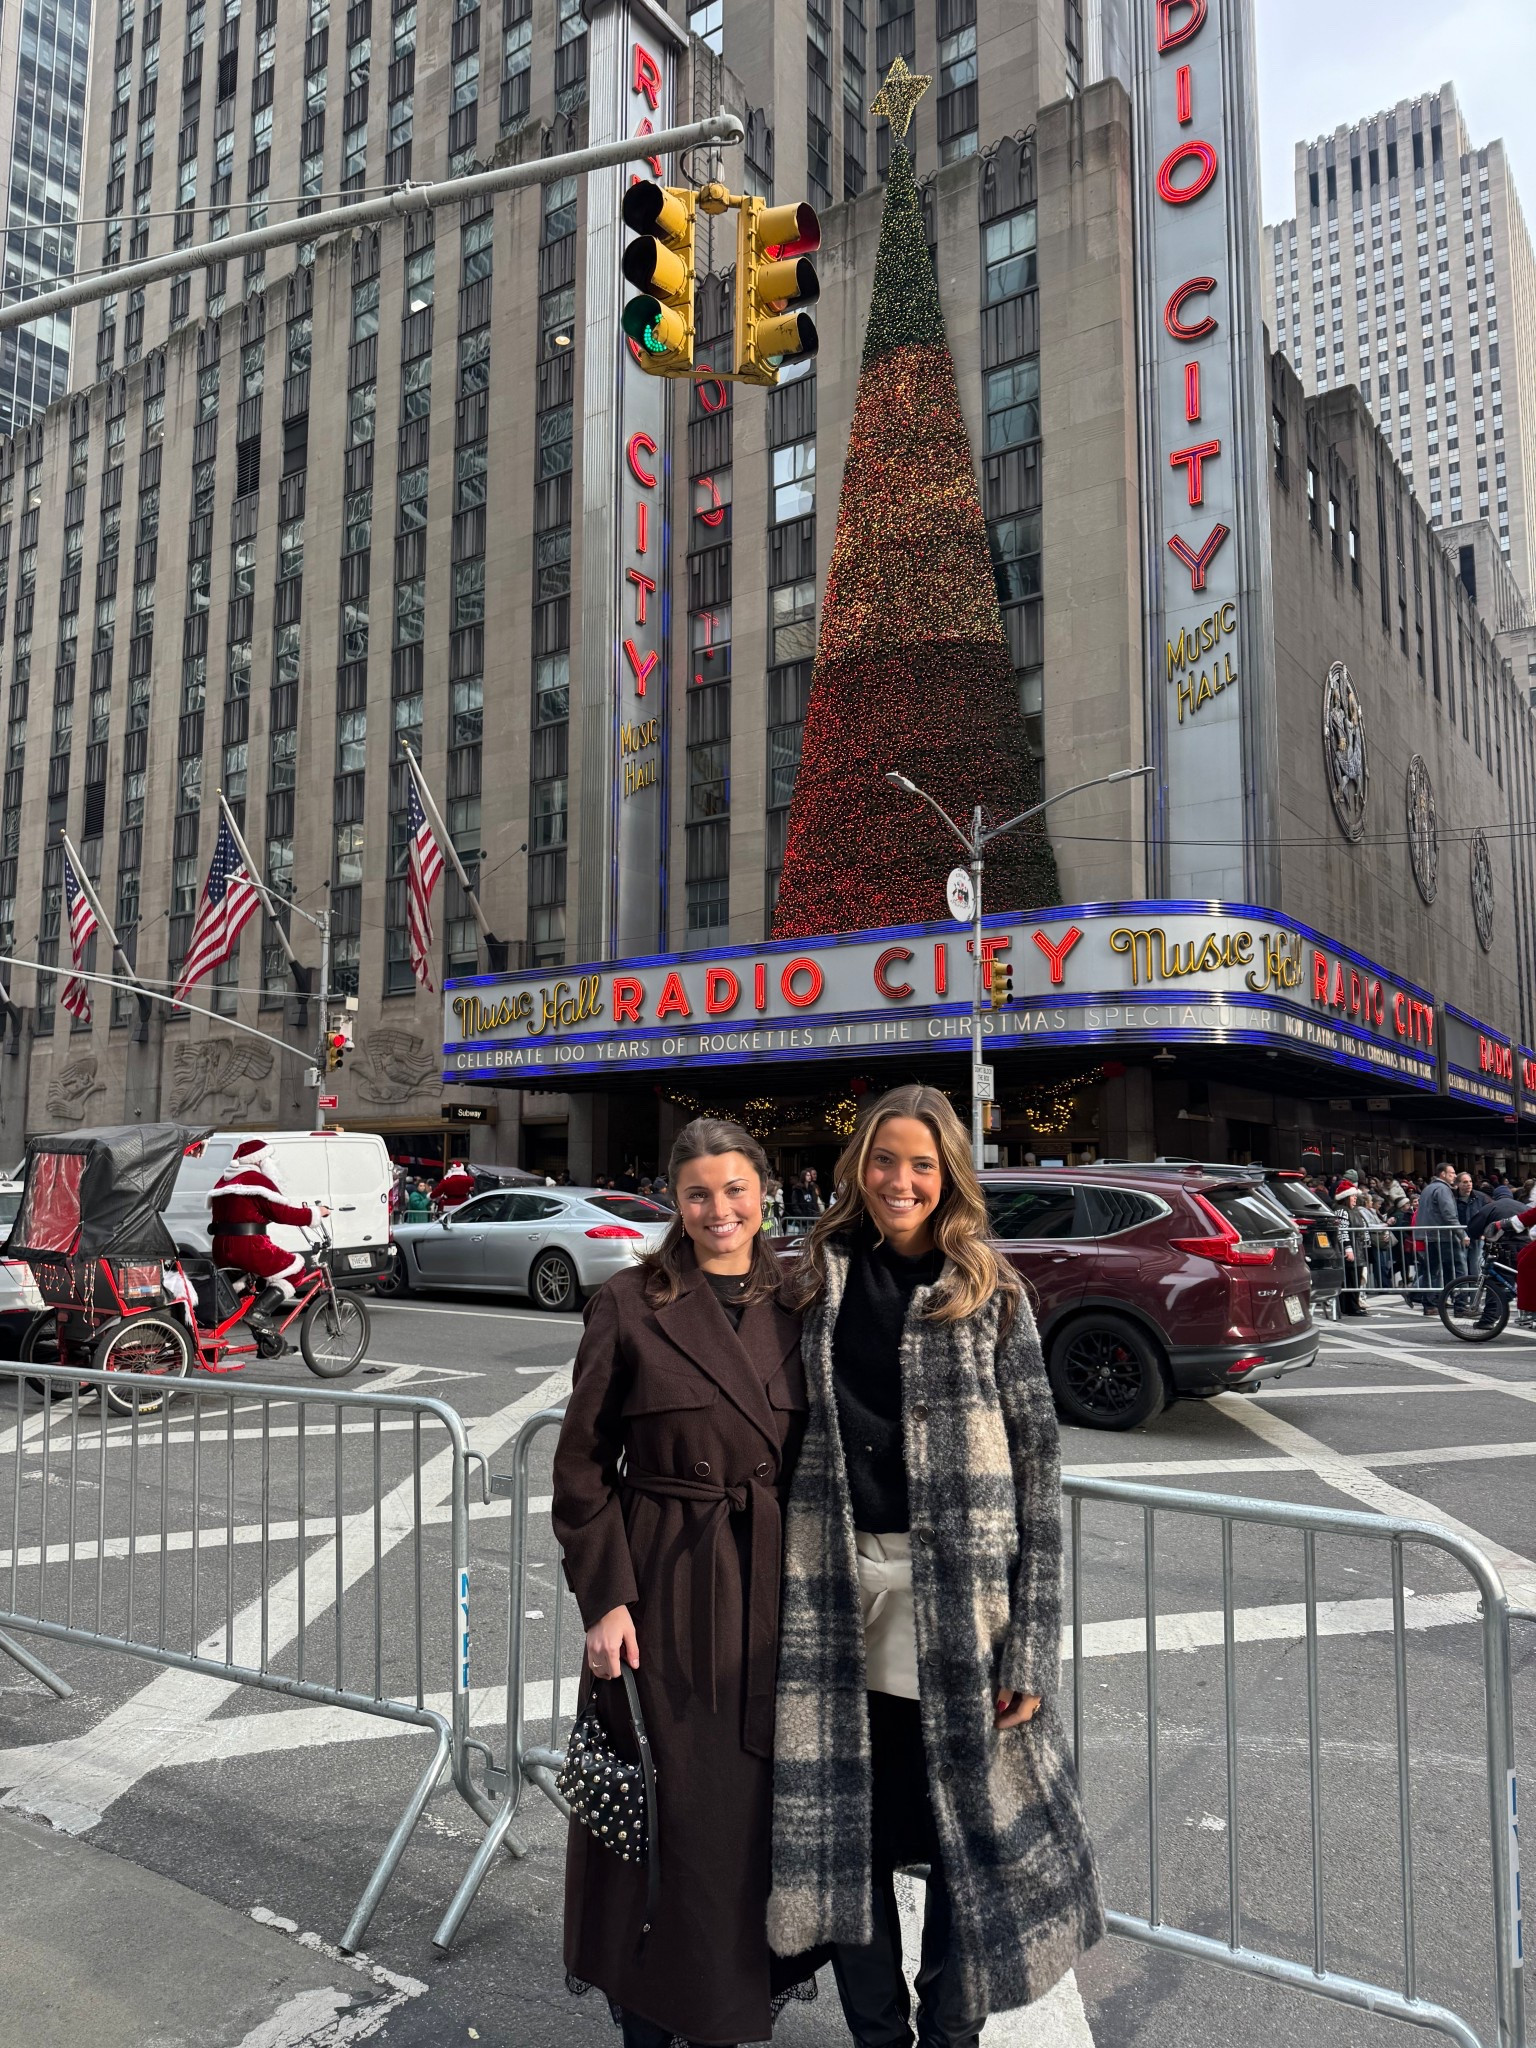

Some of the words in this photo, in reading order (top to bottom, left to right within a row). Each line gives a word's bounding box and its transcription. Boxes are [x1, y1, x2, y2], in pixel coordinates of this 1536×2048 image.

[1163, 276, 1231, 592] CITY
[623, 431, 659, 698] CITY
[1167, 602, 1237, 684] MUSIC
[1177, 652, 1238, 725] HALL
[620, 717, 659, 759] MUSIC
[623, 757, 657, 799] HALL
[453, 990, 535, 1039] Music
[527, 974, 602, 1037] Hall
[613, 956, 824, 1023] RADIO
[873, 925, 1084, 1000] CITY
[1110, 926, 1255, 987] Music
[1313, 950, 1384, 1026] RADIO
[1393, 992, 1435, 1047] CITY
[456, 1048, 543, 1070] CELEBRATE
[554, 1044, 585, 1063] 100
[597, 1040, 650, 1060] YEARS
[662, 1037, 687, 1056] OF
[699, 1028, 813, 1053] ROCKETTES
[828, 1024, 854, 1044] AT
[873, 1021, 909, 1041] THE
[928, 1008, 1066, 1039] CHRSTMAS
[1088, 1004, 1278, 1030] SPECTACULAR!
[1284, 1015, 1304, 1038] NOW
[1307, 1022, 1338, 1049] PLAYING
[1341, 1034, 1356, 1054] THIS
[1479, 1034, 1512, 1080] RADIO
[457, 1108, 482, 1119] Subway
